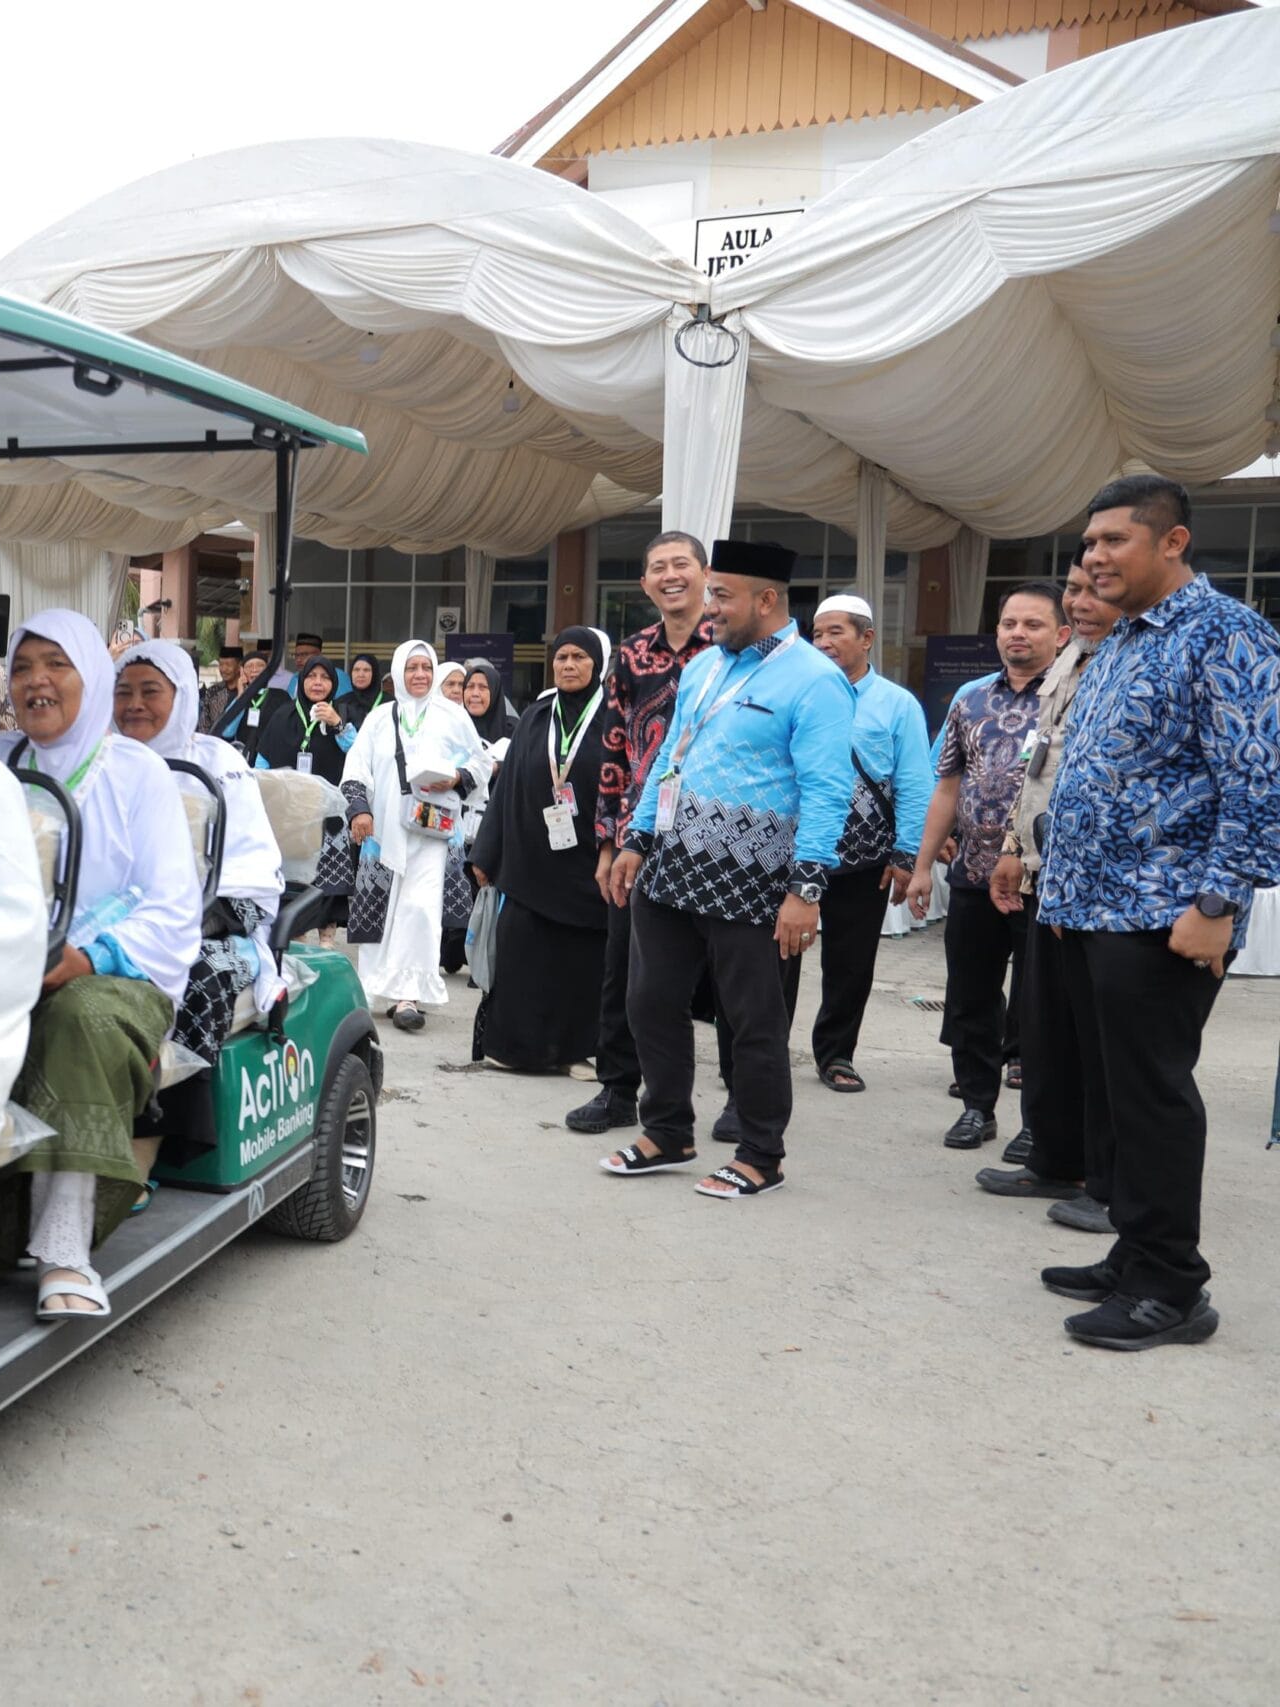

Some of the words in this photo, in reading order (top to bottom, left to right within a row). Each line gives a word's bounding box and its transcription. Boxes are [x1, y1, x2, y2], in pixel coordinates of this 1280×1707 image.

[720, 227, 773, 251] AULA
[239, 1126, 276, 1167] Mobile
[277, 1102, 314, 1141] Banking
